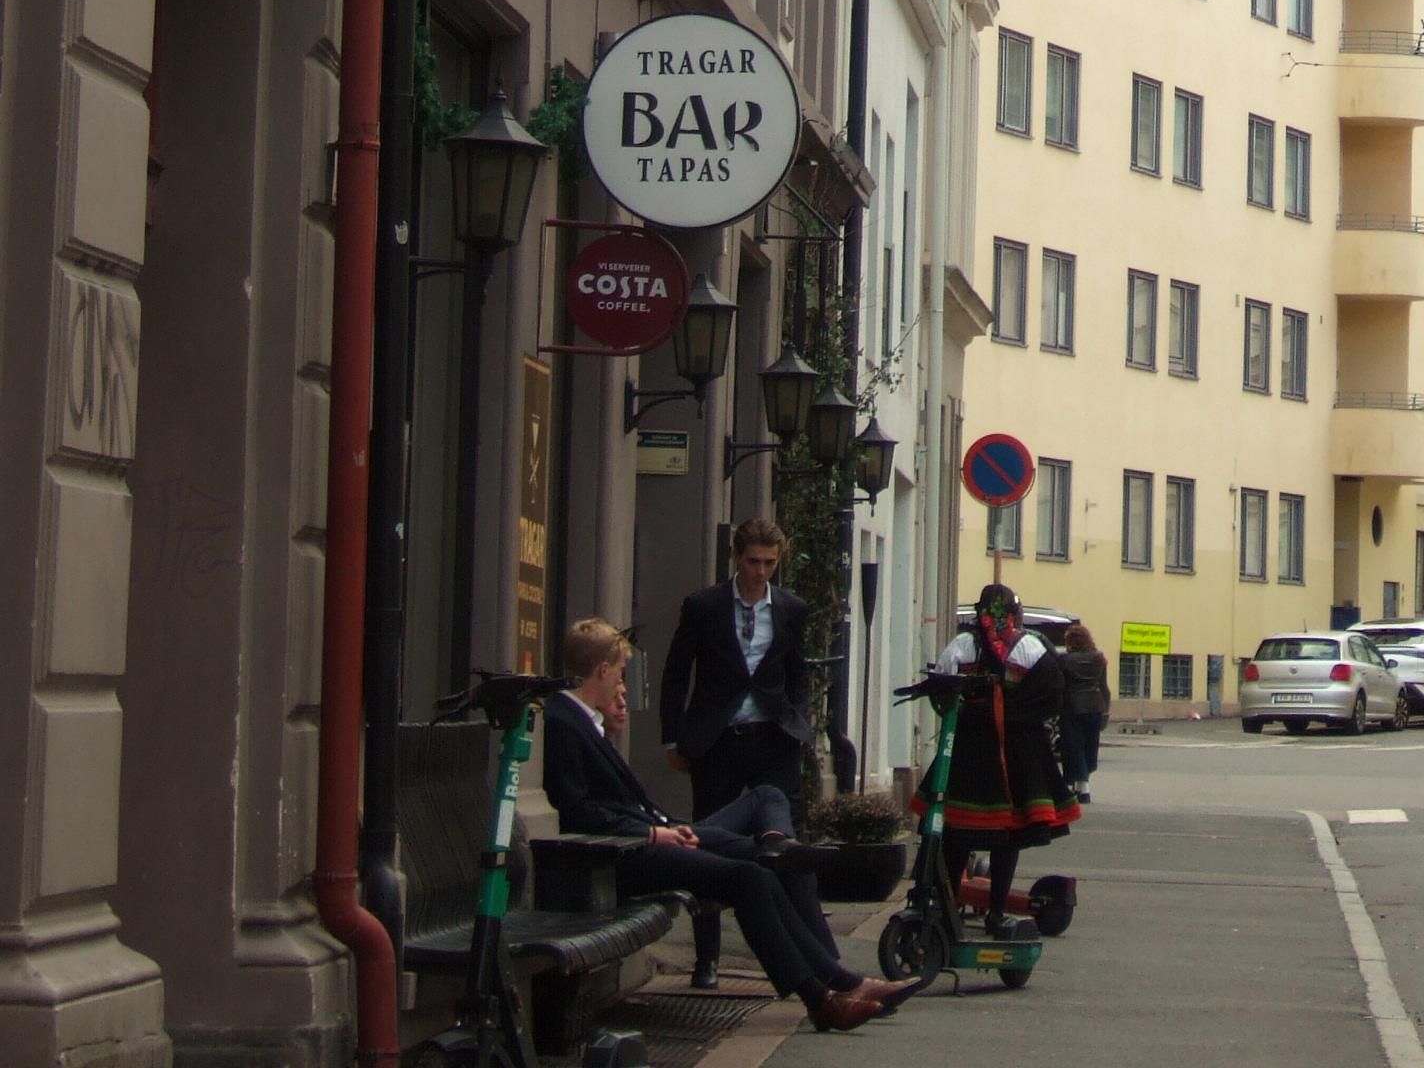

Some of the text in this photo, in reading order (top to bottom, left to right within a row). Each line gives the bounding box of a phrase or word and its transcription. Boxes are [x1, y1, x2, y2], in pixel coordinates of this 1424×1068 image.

[637, 48, 757, 76] TRAGAR
[621, 91, 763, 153] BAR
[637, 157, 731, 183] TAPAS
[597, 262, 608, 270] VI
[577, 273, 668, 299] COSTA
[597, 300, 648, 313] COFFEE
